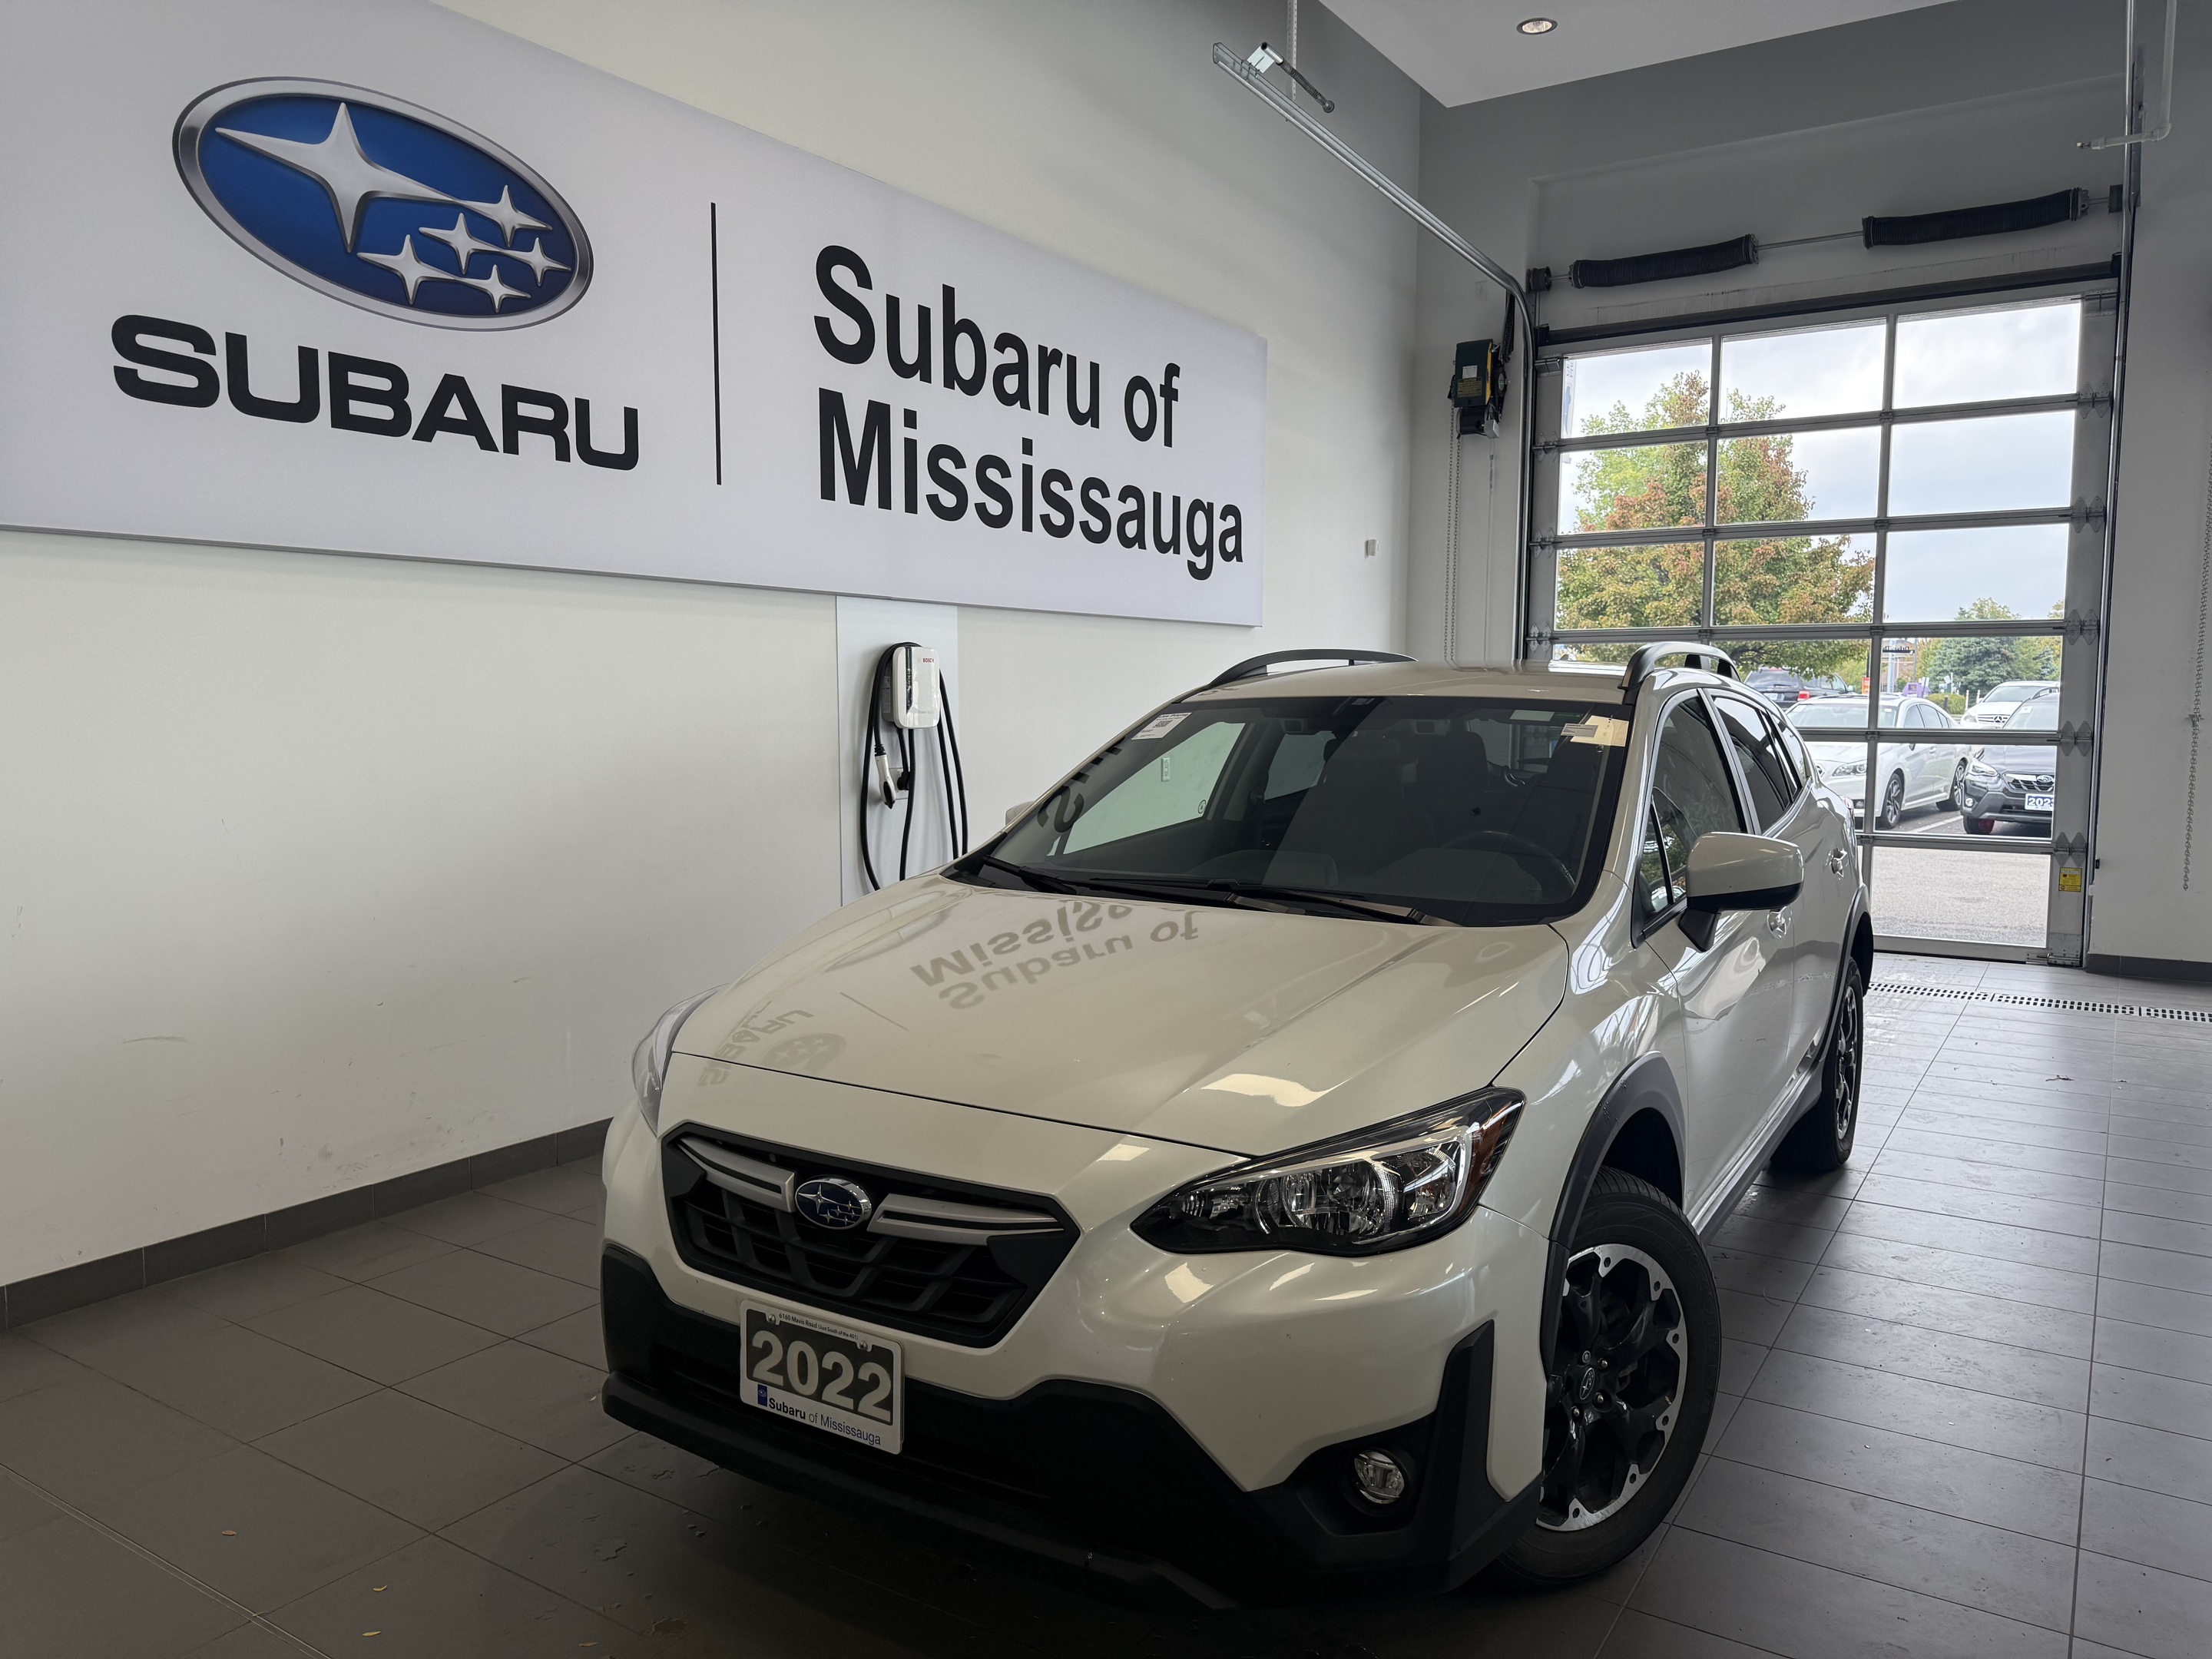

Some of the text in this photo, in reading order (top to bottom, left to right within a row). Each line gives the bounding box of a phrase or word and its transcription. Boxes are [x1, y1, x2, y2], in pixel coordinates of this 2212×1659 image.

[111, 314, 639, 471] SUBARU
[814, 245, 1181, 448] Subaru of
[819, 387, 1243, 580] Mississauga
[752, 1330, 892, 1422] 2022
[779, 1313, 791, 1321] 6160
[792, 1316, 804, 1325] Mavis
[805, 1320, 817, 1329] Road
[769, 1397, 882, 1446] Subaru of Mississauga
